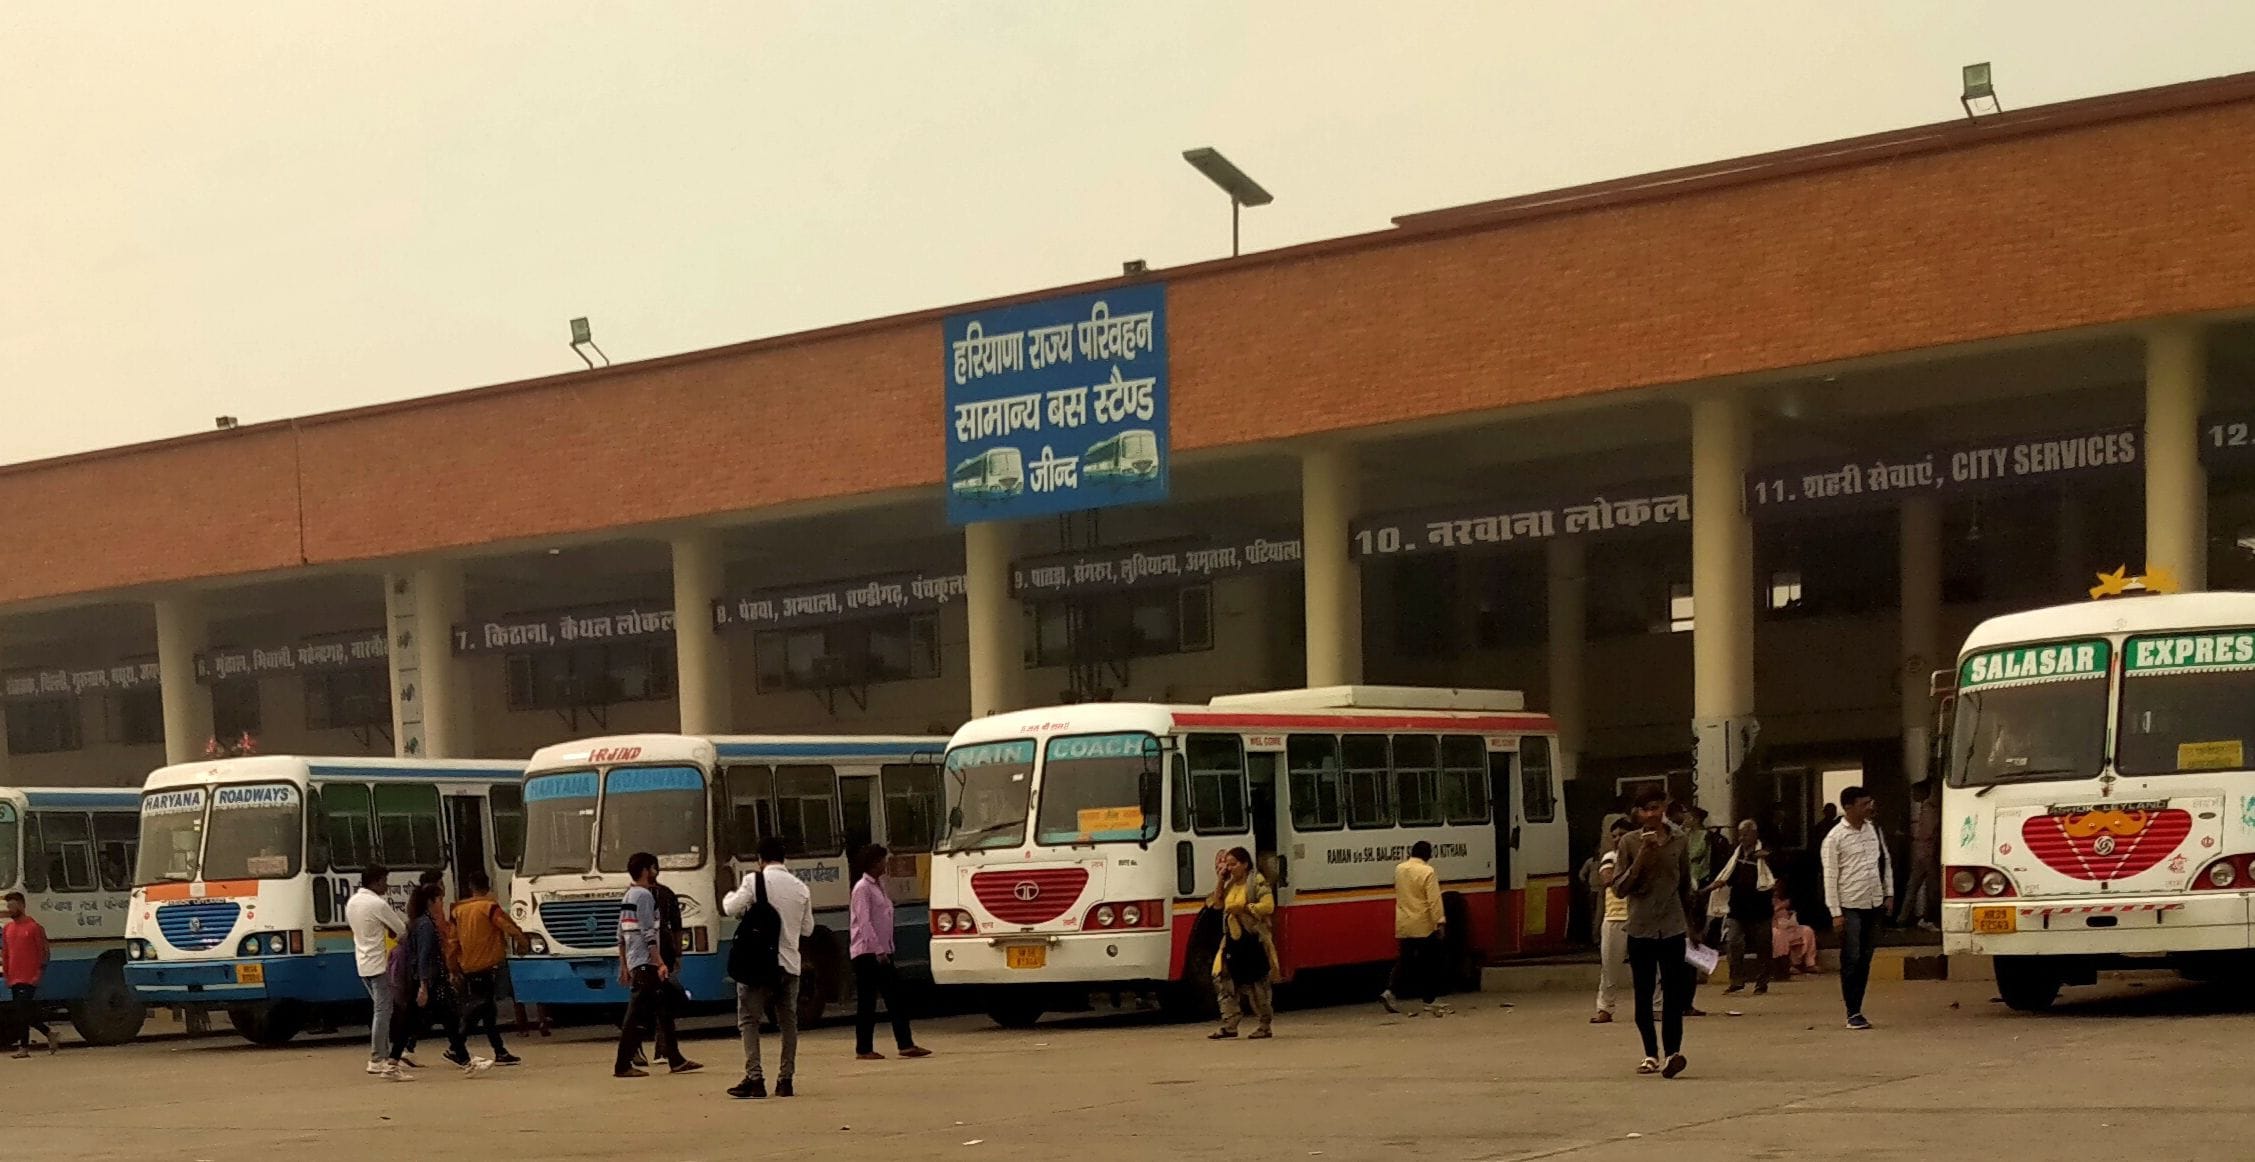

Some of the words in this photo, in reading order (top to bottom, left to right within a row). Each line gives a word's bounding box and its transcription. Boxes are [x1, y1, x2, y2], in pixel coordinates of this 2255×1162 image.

[952, 320, 1025, 386] हरियाणा
[1028, 323, 1076, 370] राज्य
[1076, 300, 1154, 361] परिवहन
[954, 392, 1042, 443] सामान्य
[1046, 386, 1089, 428] बस
[1092, 364, 1157, 425] स्टैण्ड
[1028, 444, 1080, 494] जीन्द
[1753, 480, 1796, 504] 11.
[1801, 461, 1863, 500] शहरी
[1951, 446, 2008, 484] CITY
[2013, 431, 2137, 477] SERVICES
[1354, 526, 1417, 555] 10.
[1426, 510, 1556, 547] नरवाना
[1562, 494, 1692, 534] लोकल
[1014, 570, 1029, 589] 9.
[455, 631, 476, 650] 7.
[1970, 646, 2094, 682] SALASAR
[1053, 737, 1144, 758] COACH
[145, 791, 200, 811] HARYANA
[219, 787, 289, 804] ROADWAYS
[2102, 800, 2167, 812] LEYLAND
[1327, 848, 1352, 865] RAMAN
